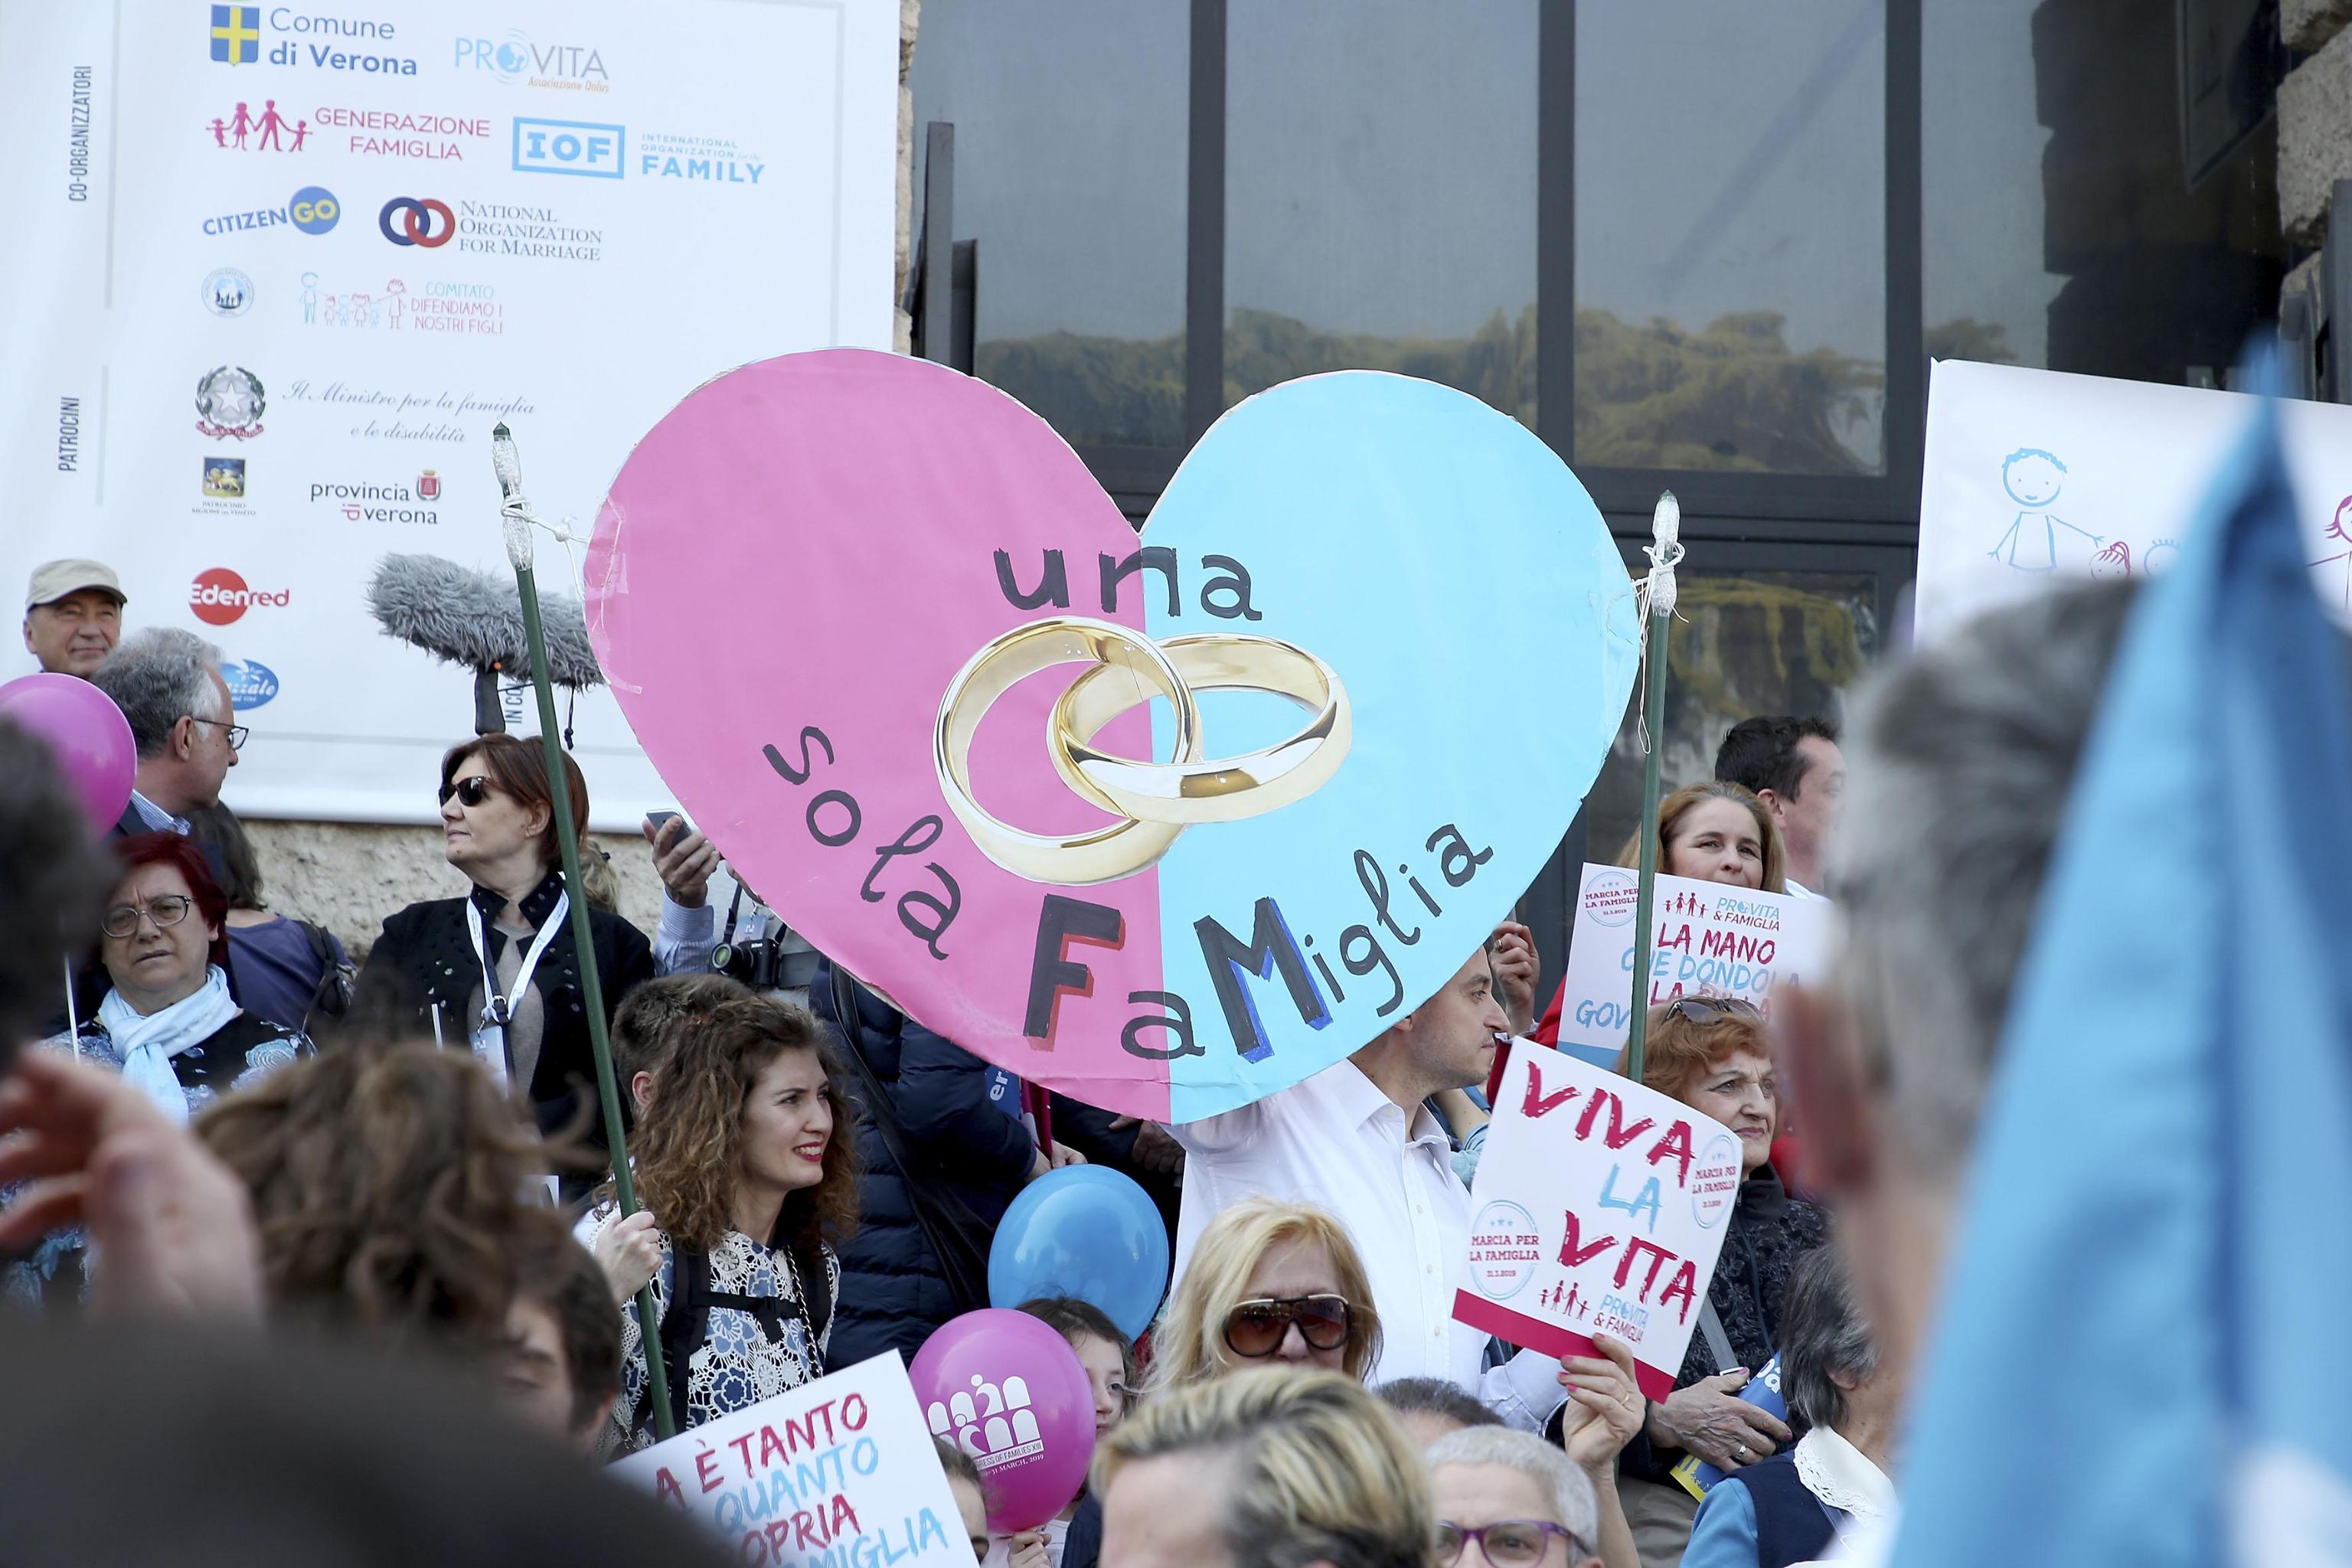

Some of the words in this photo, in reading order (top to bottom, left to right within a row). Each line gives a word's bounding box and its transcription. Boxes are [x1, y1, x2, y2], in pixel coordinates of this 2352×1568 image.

[270, 7, 395, 39] Comune
[269, 41, 297, 66] di
[309, 44, 417, 76] Verona
[68, 65, 91, 201] CO-ORGANIZZATORI
[315, 106, 491, 137] GENERAZIONE
[350, 135, 463, 161] FAMIGLIA
[526, 131, 611, 163] IOF
[641, 143, 734, 158] ORGANIZATION
[642, 132, 739, 149] INTERNATIONAL
[642, 155, 766, 184] FAMILY
[459, 237, 496, 253] FOR
[425, 281, 494, 300] COMITATO
[410, 297, 494, 318] DIFENDIAMO
[414, 315, 464, 333] NOSTRI
[469, 318, 503, 335] FIGLI
[309, 381, 396, 405] Ministro
[397, 392, 431, 413] per
[436, 391, 454, 410] la
[455, 392, 536, 420] famiglia
[58, 396, 80, 472] PATROCINI
[364, 419, 380, 438] le
[310, 482, 410, 502] provincia
[364, 507, 439, 525] verona
[188, 583, 290, 608] Edenred
[993, 546, 1263, 621] una
[762, 726, 961, 962] sola
[1585, 890, 1621, 900] MARCIA
[1585, 900, 1598, 909] LA
[1724, 912, 1780, 932] FAMIGLIA
[1658, 921, 1692, 956] LA
[1700, 929, 1776, 965] MANO
[1576, 999, 1631, 1030] GOV
[1521, 1060, 1697, 1189] VIVA
[1598, 1162, 1663, 1234] LA
[1471, 1234, 1512, 1246] MARCIA
[1515, 1234, 1540, 1246] PER
[1468, 1250, 1482, 1262] LA
[1485, 1250, 1540, 1261] FAMIGLIA
[1557, 1209, 1697, 1327] VITA
[694, 1439, 725, 1494] È
[728, 1392, 869, 1479] TANTO
[1004, 1445, 1032, 1460] FAMILIES
[1029, 1454, 1044, 1463] 2019
[714, 1436, 879, 1534] QUANTO
[738, 1493, 862, 1568] OPRIA
